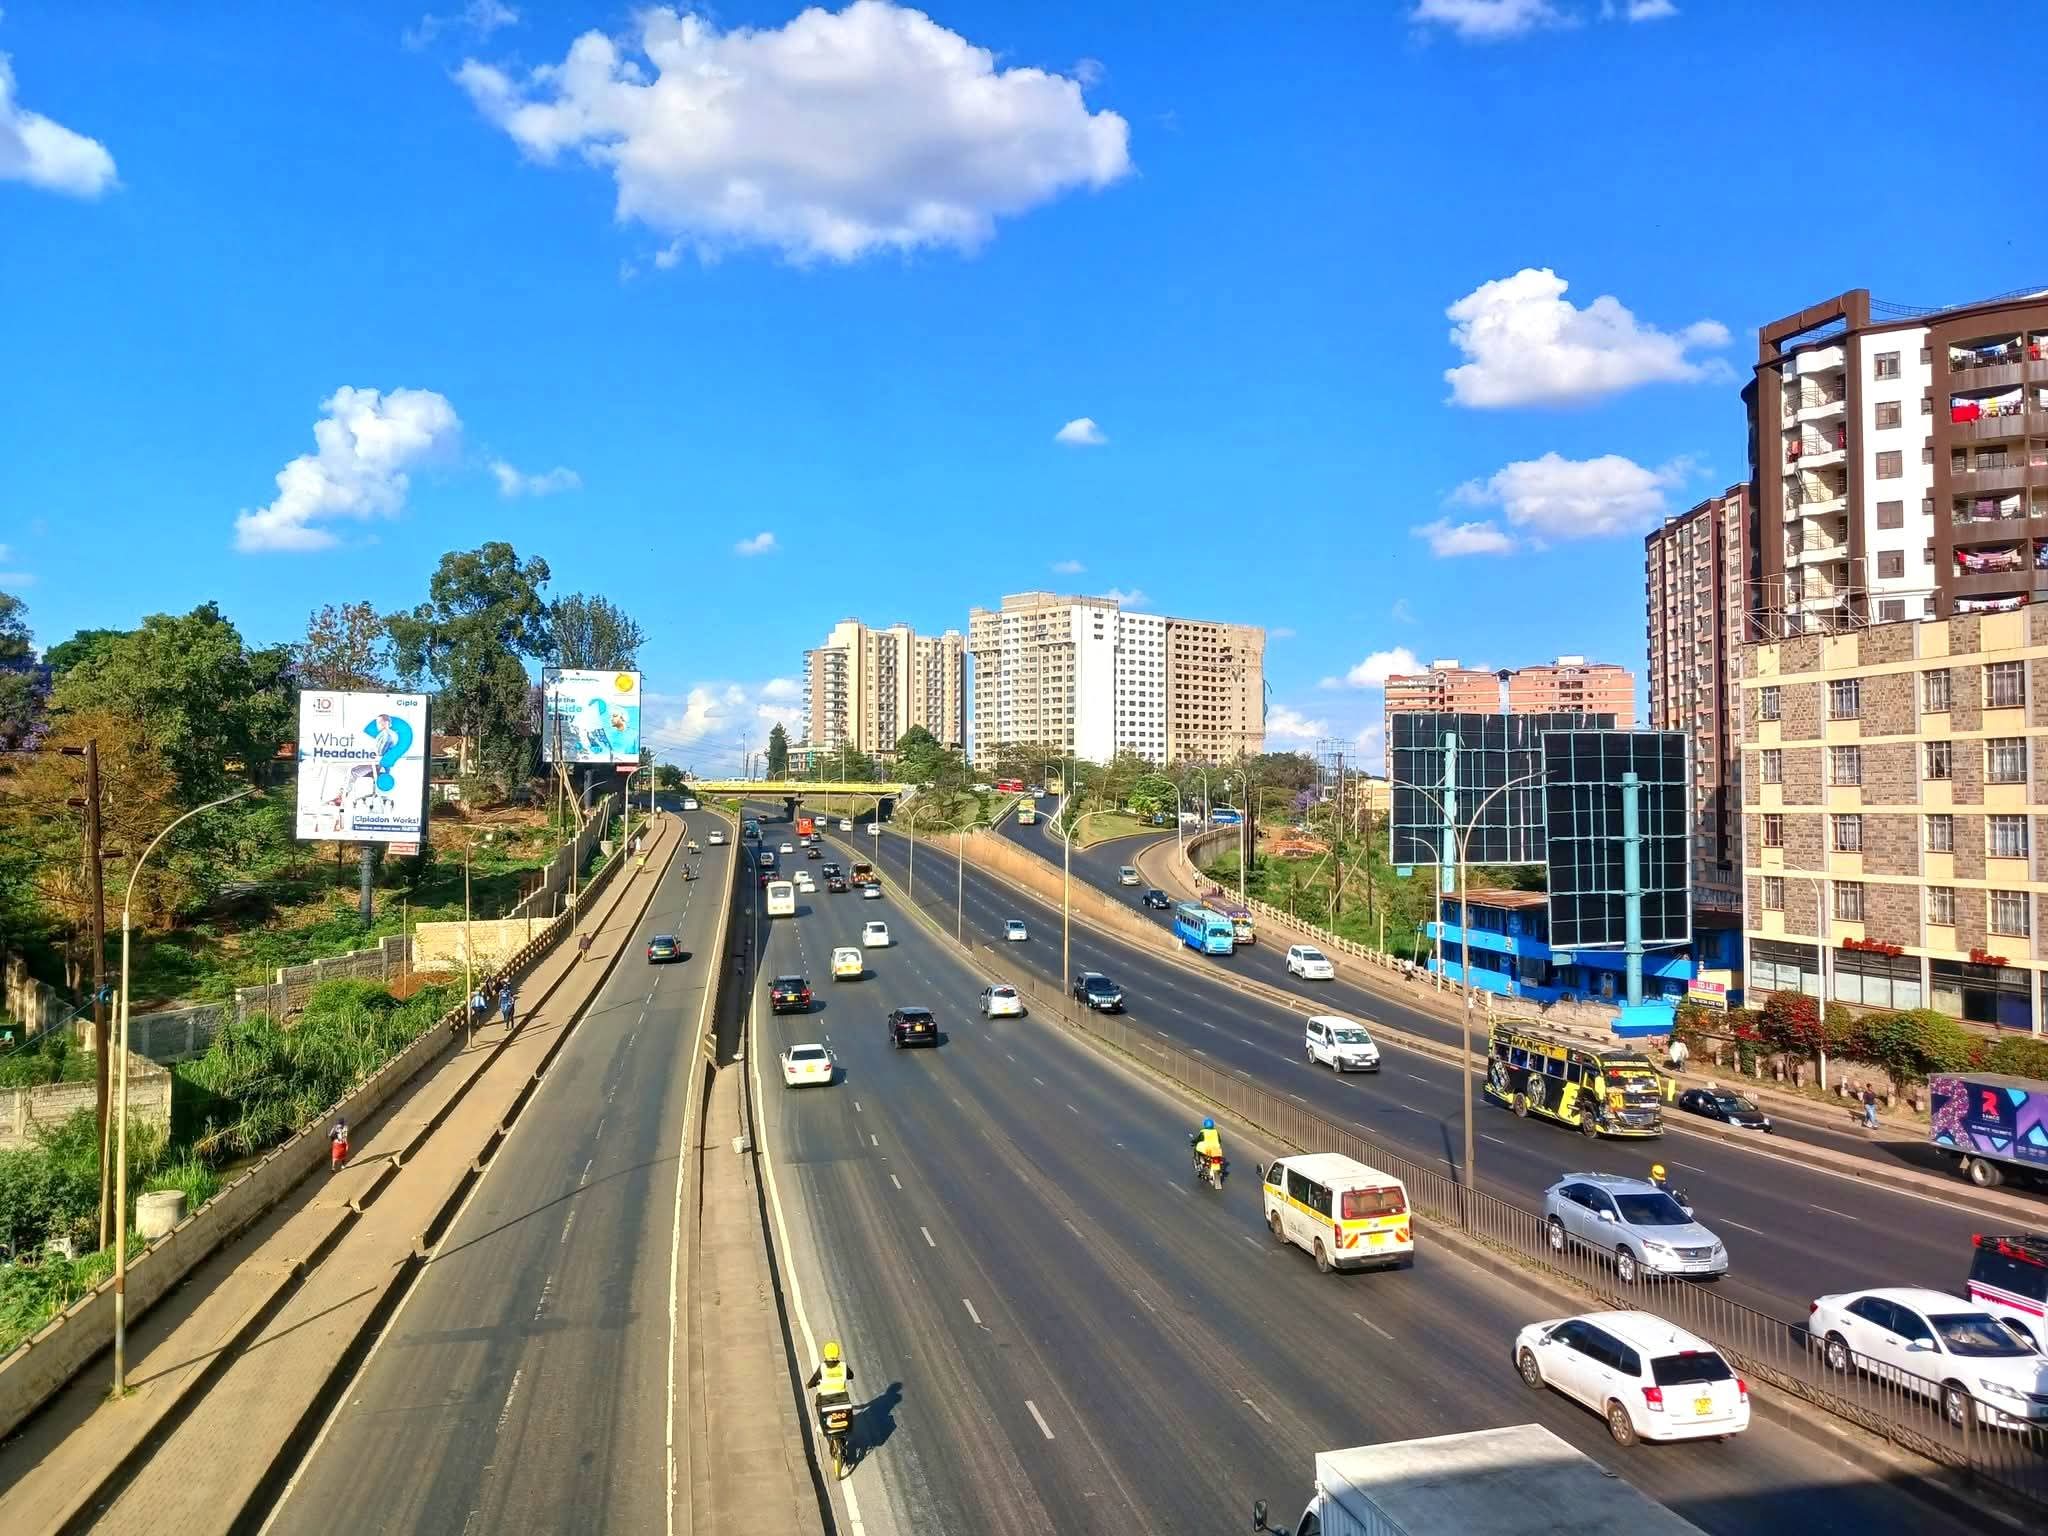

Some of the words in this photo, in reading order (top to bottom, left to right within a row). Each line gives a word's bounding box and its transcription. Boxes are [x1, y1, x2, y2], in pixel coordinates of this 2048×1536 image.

[396, 699, 418, 707] Cipla
[313, 732, 355, 748] What
[313, 747, 377, 760] Headache
[392, 816, 419, 825] Works!
